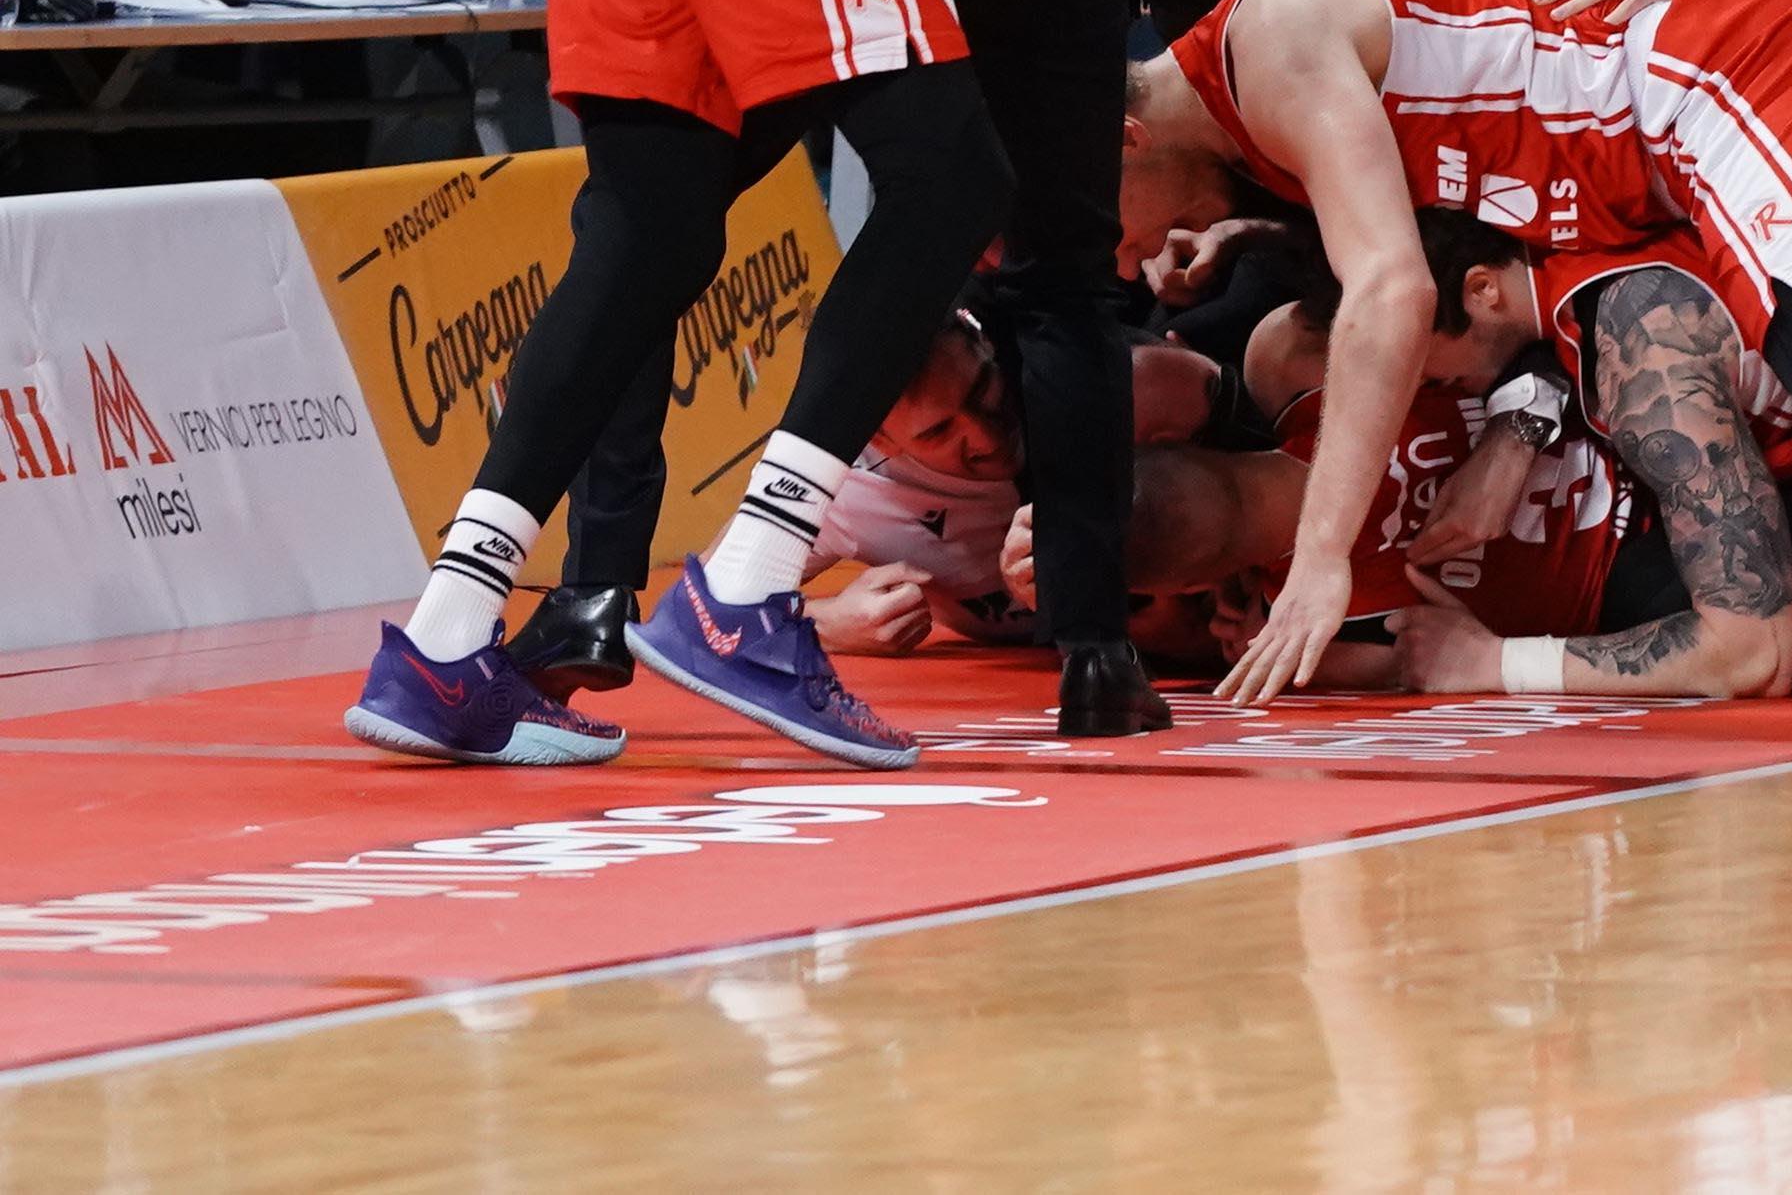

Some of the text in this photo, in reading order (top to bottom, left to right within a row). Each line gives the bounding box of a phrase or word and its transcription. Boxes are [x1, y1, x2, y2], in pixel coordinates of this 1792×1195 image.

[1436, 144, 1468, 210] EM
[384, 170, 477, 259] PROSCIUTTO
[1549, 177, 1580, 251] ELS
[0, 385, 77, 483] AL
[169, 395, 358, 455] VERNICI PER LEGNO
[116, 472, 202, 540] milesi
[775, 476, 812, 499] NIKE
[487, 536, 517, 560] NIKE
